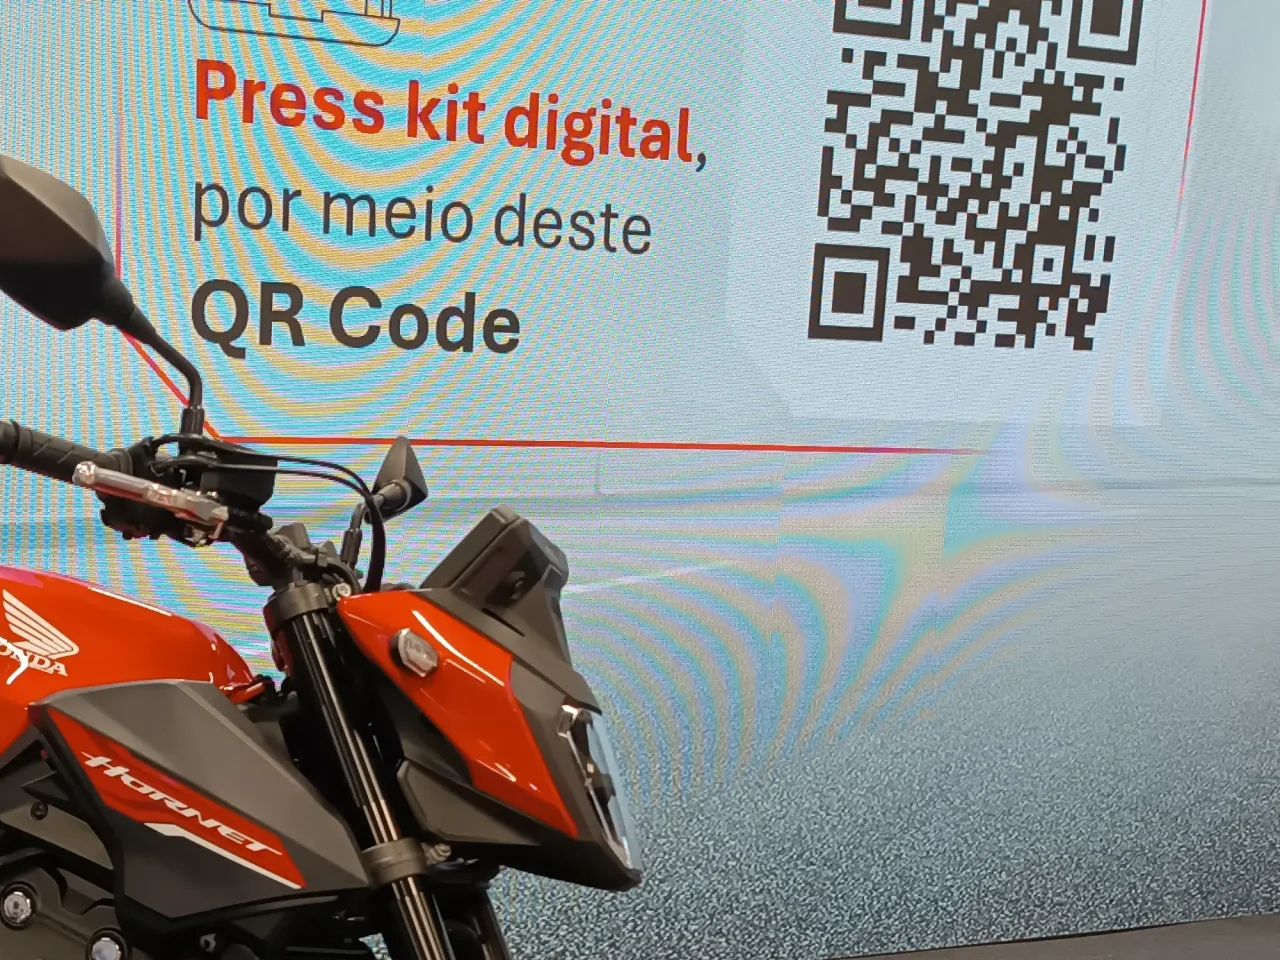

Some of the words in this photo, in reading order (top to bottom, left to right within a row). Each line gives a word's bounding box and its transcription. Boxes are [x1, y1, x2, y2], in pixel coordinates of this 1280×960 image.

[195, 59, 385, 135] Press
[407, 80, 487, 145] kit
[504, 92, 708, 173] digital,
[193, 181, 303, 241] por
[322, 185, 475, 243] meio
[494, 192, 652, 255] deste
[191, 279, 306, 360] QR
[328, 286, 522, 354] Code
[81, 751, 283, 856] HORNET
